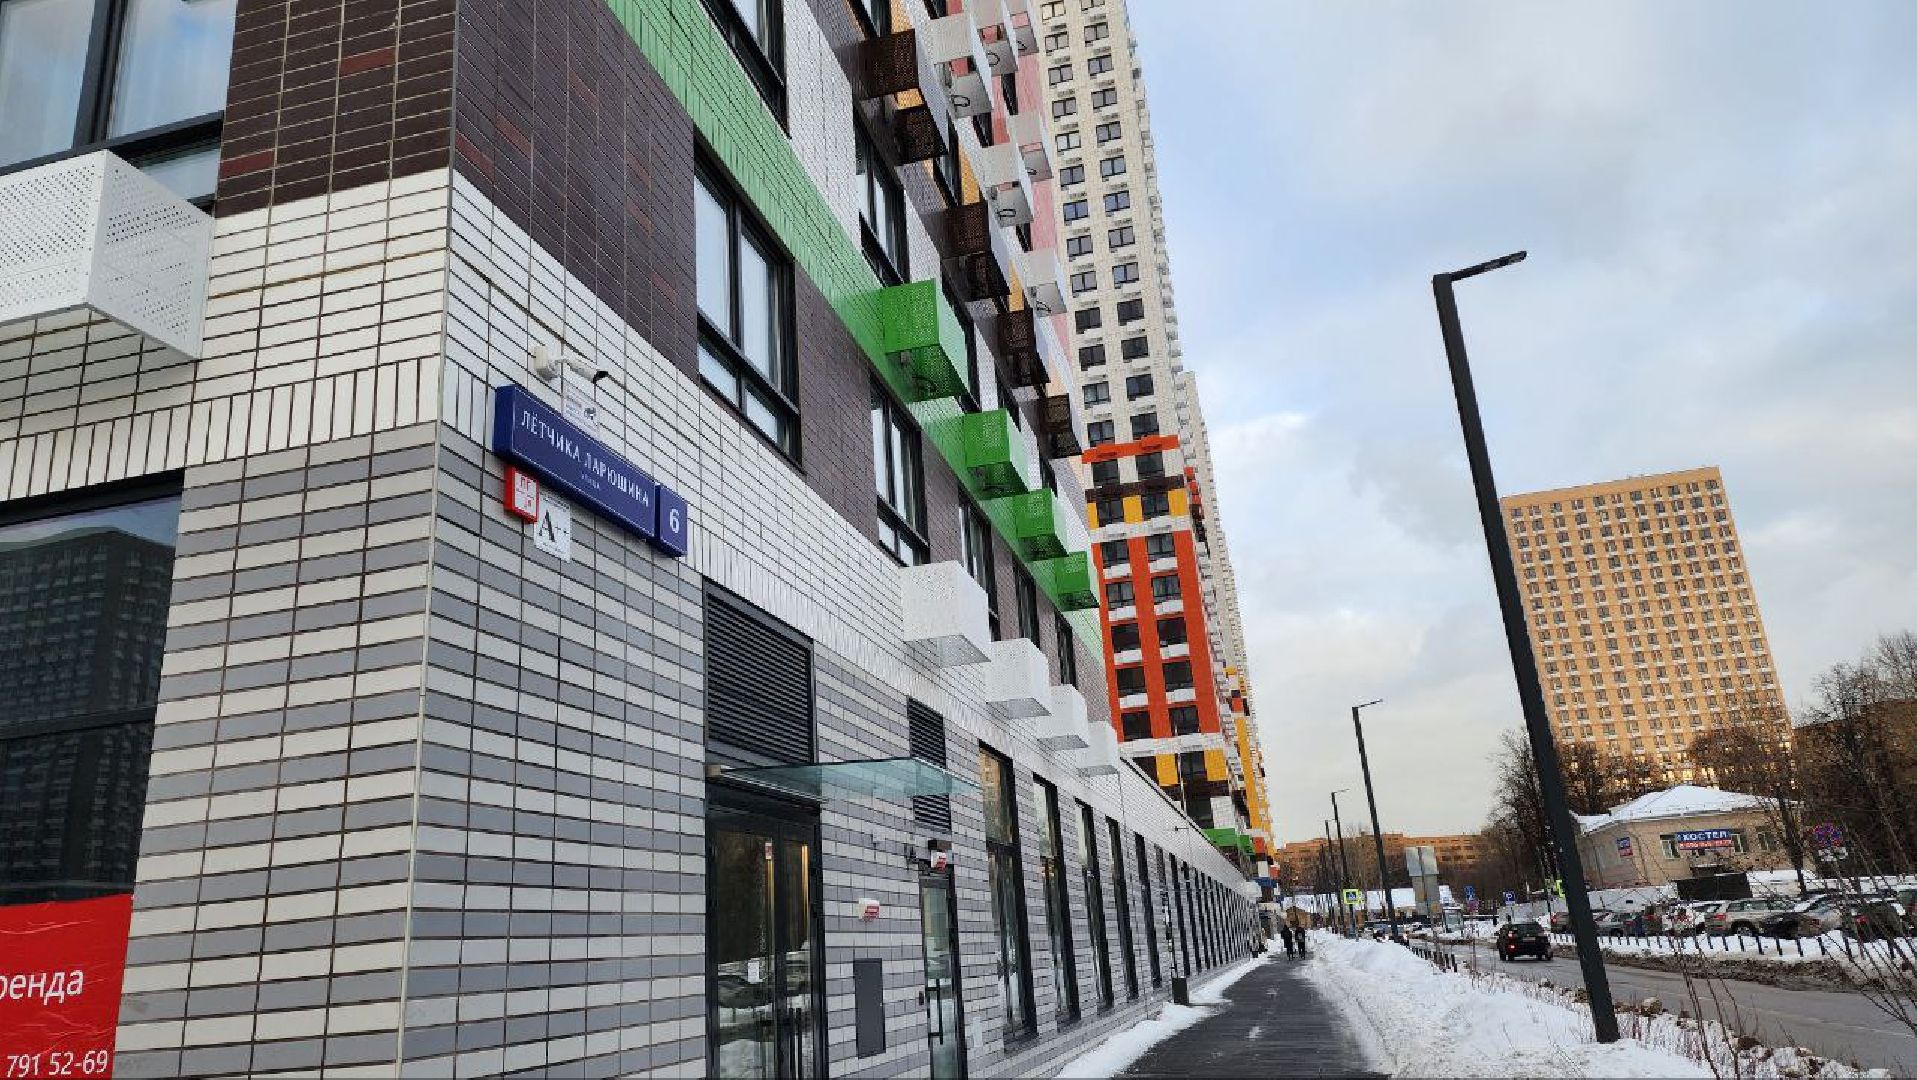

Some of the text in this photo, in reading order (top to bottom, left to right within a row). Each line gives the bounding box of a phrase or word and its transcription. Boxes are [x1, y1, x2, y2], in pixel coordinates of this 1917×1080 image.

[521, 409, 580, 462] ЛЁТЧИКА
[584, 452, 649, 507] ЛАРЮШИНА
[669, 509, 680, 534] 6
[1682, 830, 1727, 841] ХОСТЕЛ
[7, 1049, 109, 1078] 791 52-69
